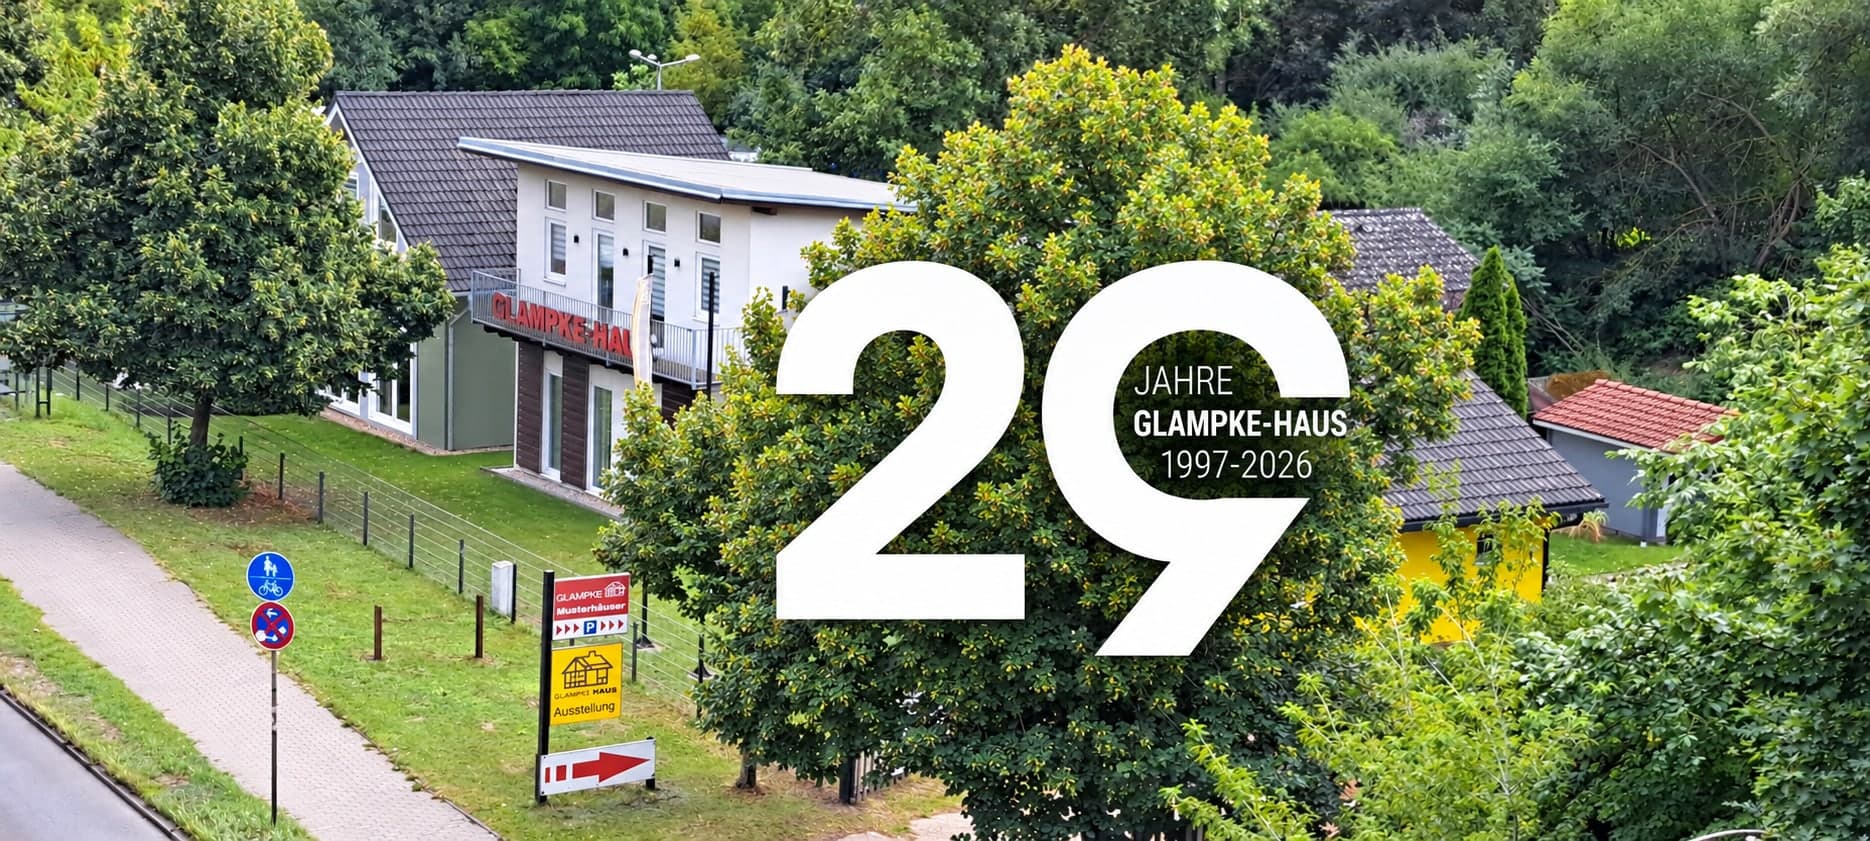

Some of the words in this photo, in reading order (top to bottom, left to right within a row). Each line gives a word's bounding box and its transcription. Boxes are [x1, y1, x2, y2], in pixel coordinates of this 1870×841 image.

[492, 291, 633, 357] GLAMPKE-HAU
[556, 590, 603, 602] GLAMPKE
[556, 603, 626, 616] Musterhäuser
[586, 622, 595, 633] P
[592, 686, 617, 695] HAUS
[553, 702, 615, 718] Ausstellung
